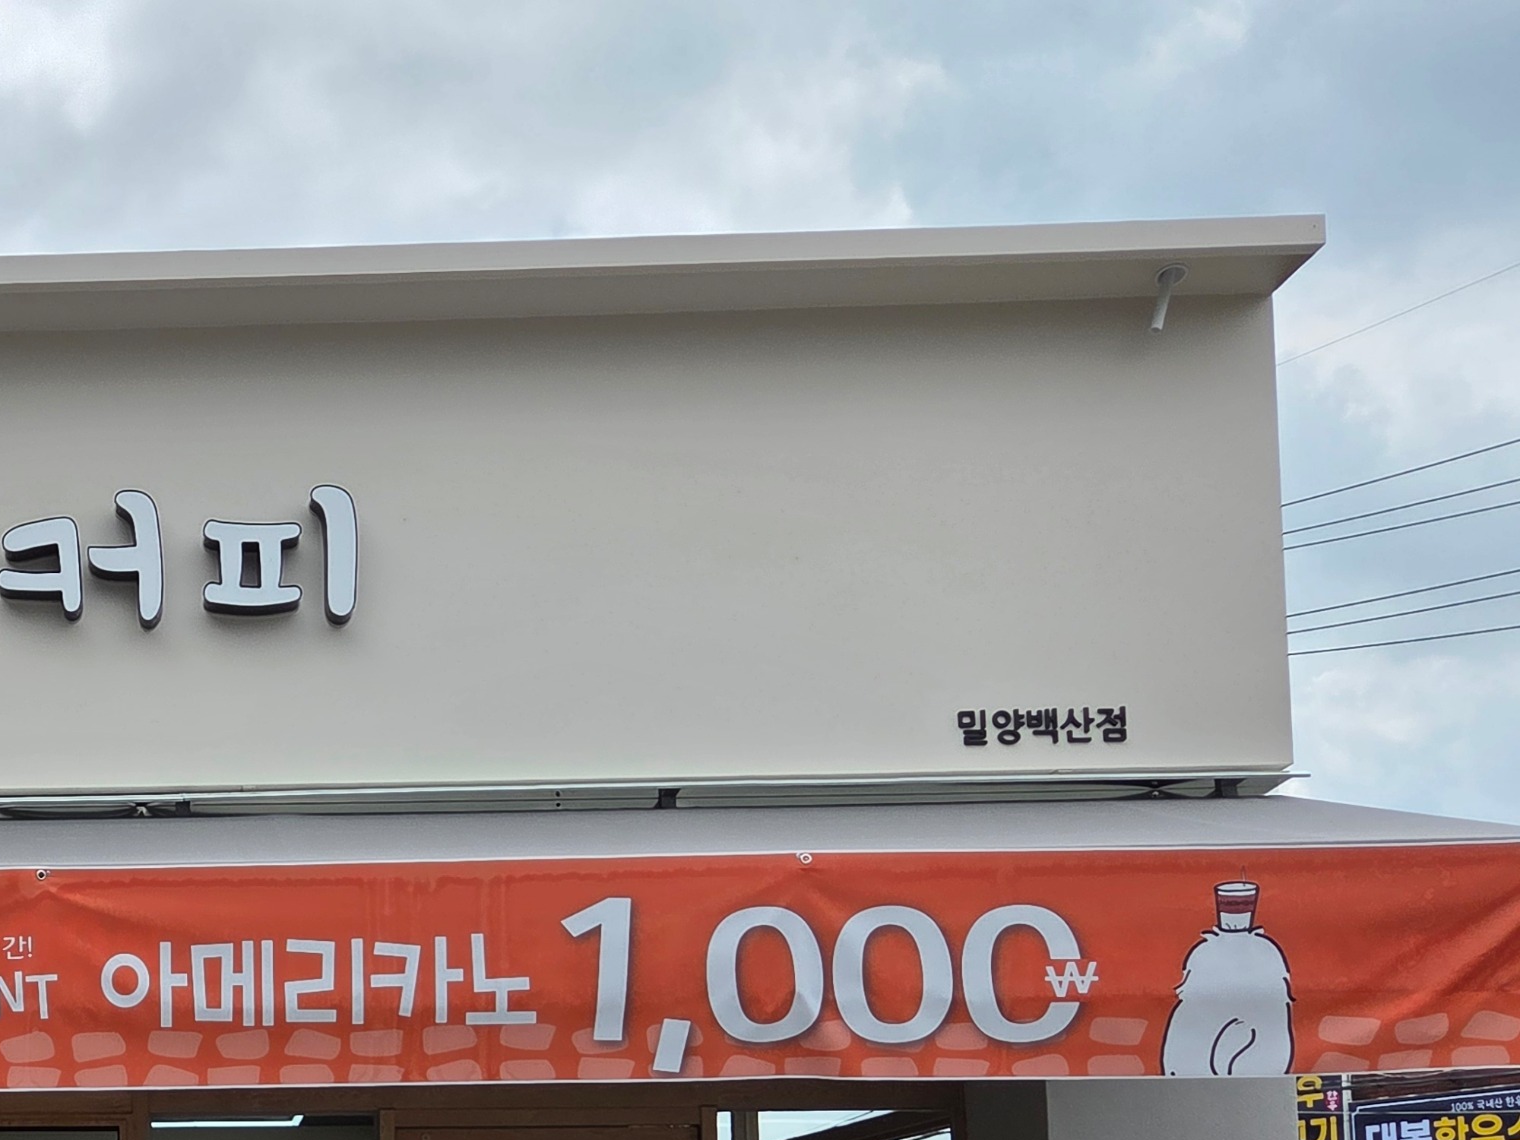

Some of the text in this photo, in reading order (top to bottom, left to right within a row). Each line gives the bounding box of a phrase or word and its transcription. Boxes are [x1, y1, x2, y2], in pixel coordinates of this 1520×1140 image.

[956, 706, 1129, 747] 밀양백산점
[2, 935, 34, 961] 간!
[100, 932, 538, 1029] 아메리카노
